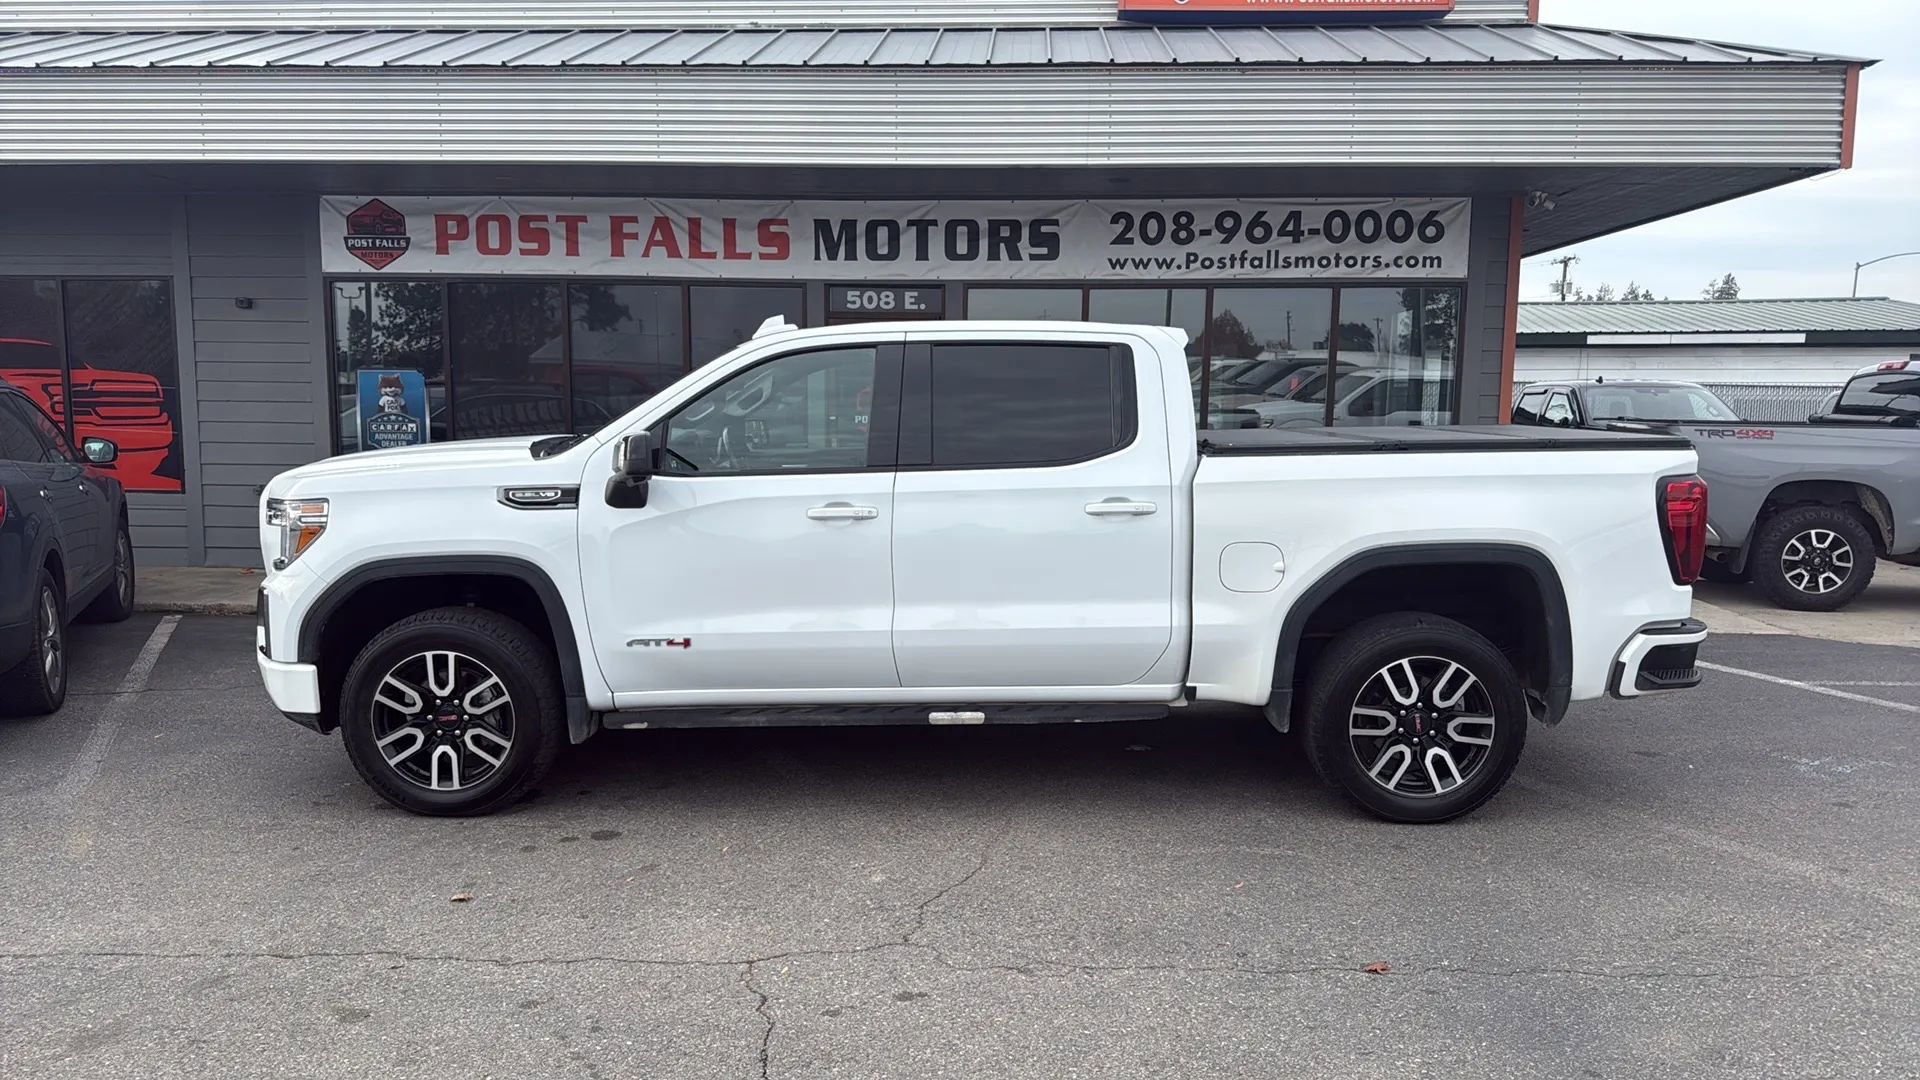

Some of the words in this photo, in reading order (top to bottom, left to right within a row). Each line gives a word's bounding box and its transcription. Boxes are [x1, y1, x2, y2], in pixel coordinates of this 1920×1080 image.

[434, 214, 588, 256] POST
[609, 215, 790, 260] FALLS
[813, 218, 1060, 262] MOTORS
[1109, 210, 1446, 246] 208-964-0006
[347, 238, 373, 248] POST
[375, 238, 407, 248] FALLS
[360, 250, 394, 259] MOTORS
[1107, 249, 1442, 271] www.Postfallsmotors.com
[846, 290, 896, 310] 508
[904, 291, 926, 310] E.
[371, 423, 416, 432] CARFAX
